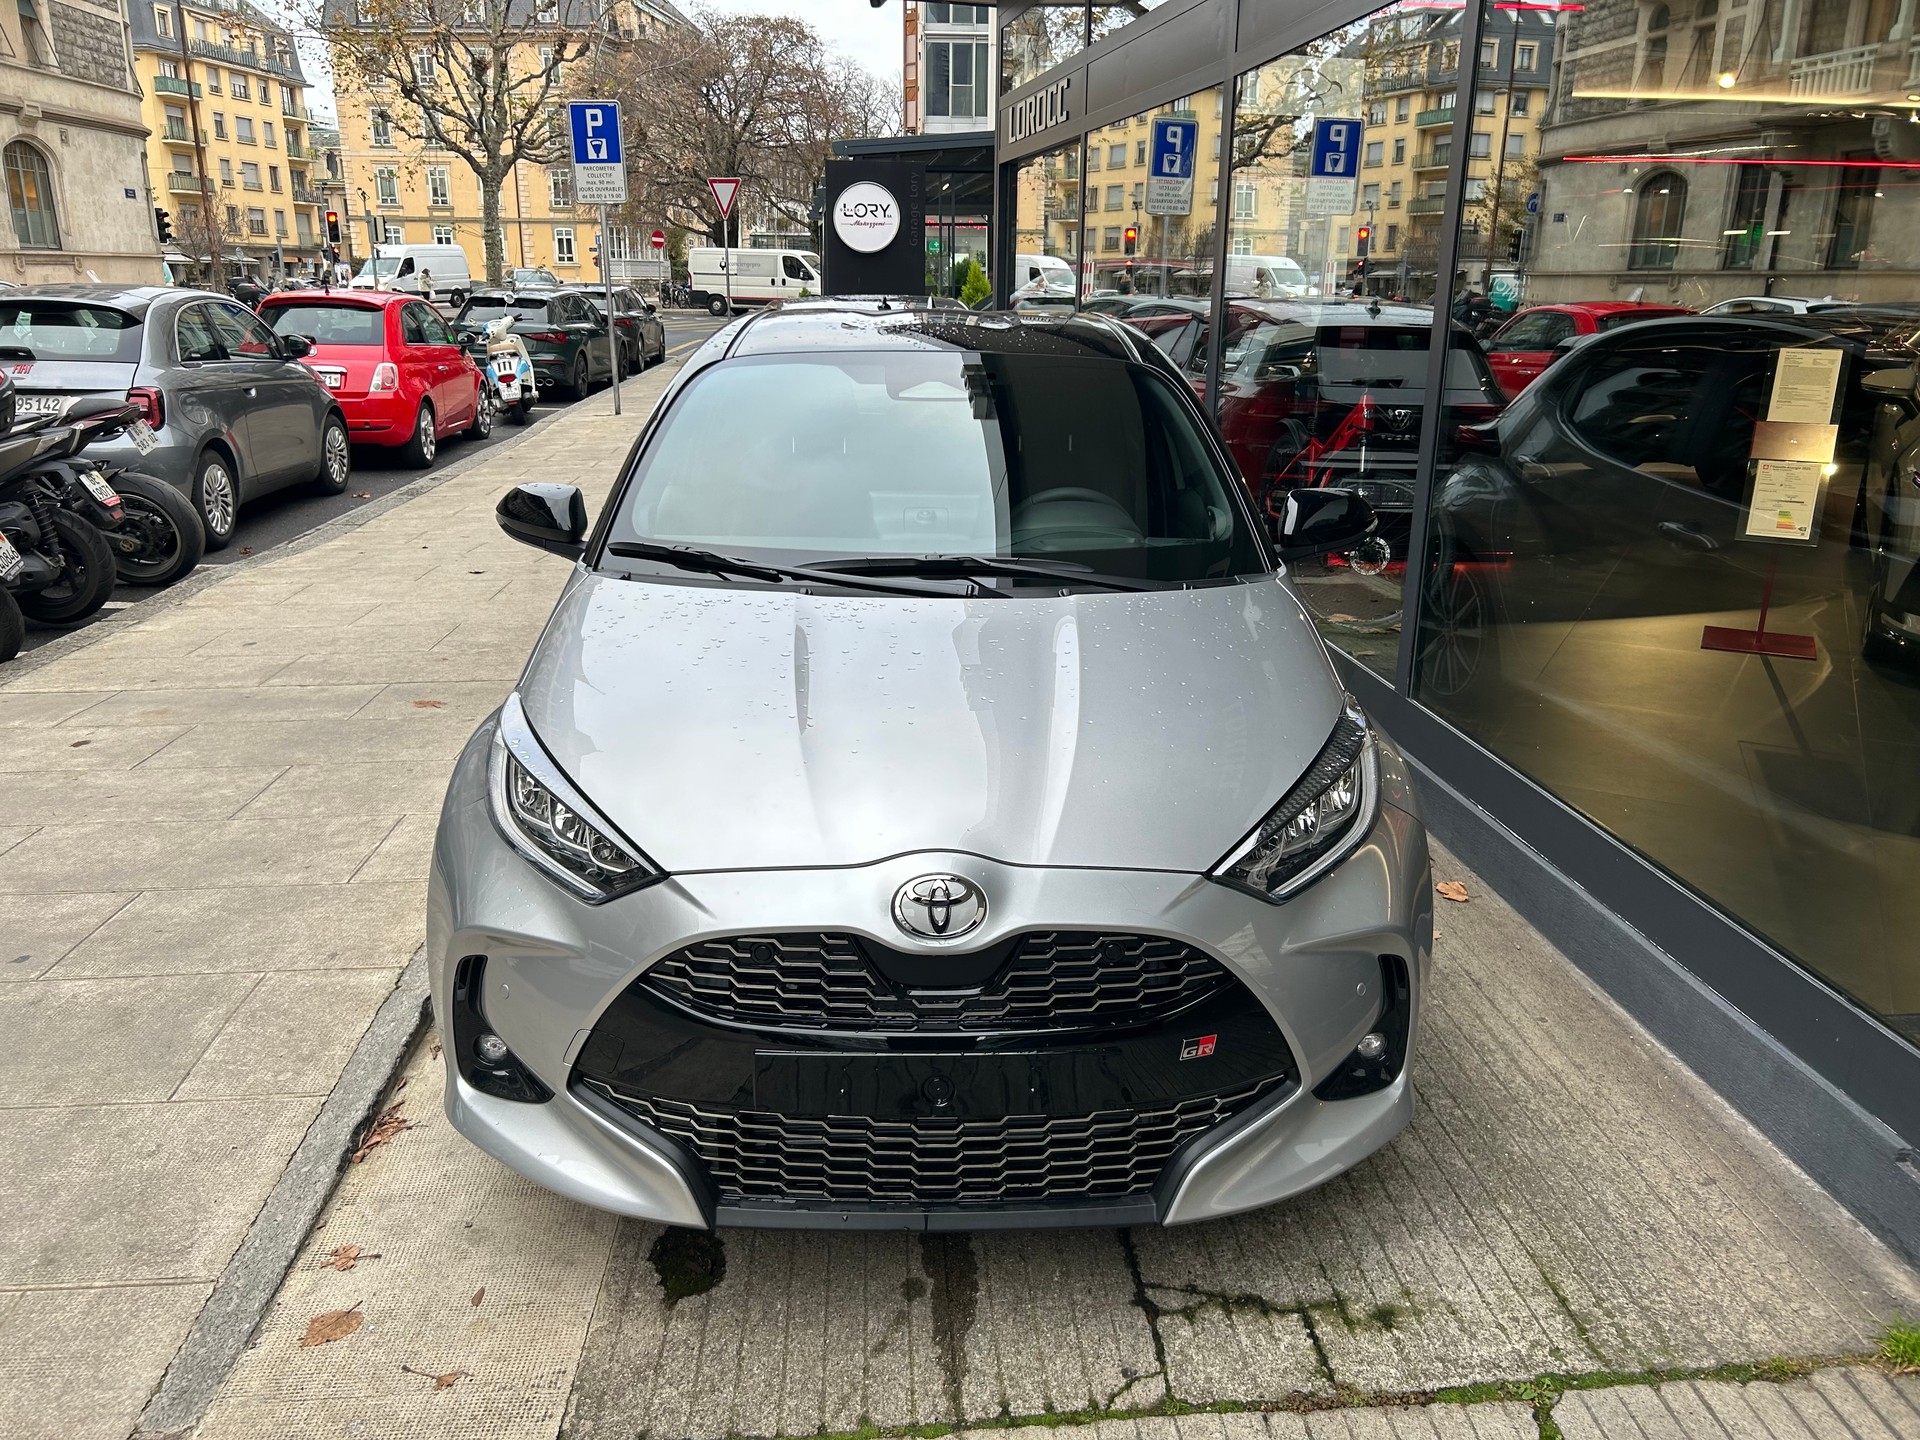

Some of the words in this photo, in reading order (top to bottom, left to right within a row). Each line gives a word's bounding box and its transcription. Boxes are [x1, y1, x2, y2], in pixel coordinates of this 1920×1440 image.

[1009, 78, 1070, 144] LOROCC
[585, 109, 603, 137] P
[910, 172, 919, 198] Lory
[843, 203, 890, 218] LORY
[910, 203, 919, 246] Garage
[12, 364, 34, 374] FIAT
[93, 484, 114, 500] 19071
[1183, 1044, 1213, 1057] GR
